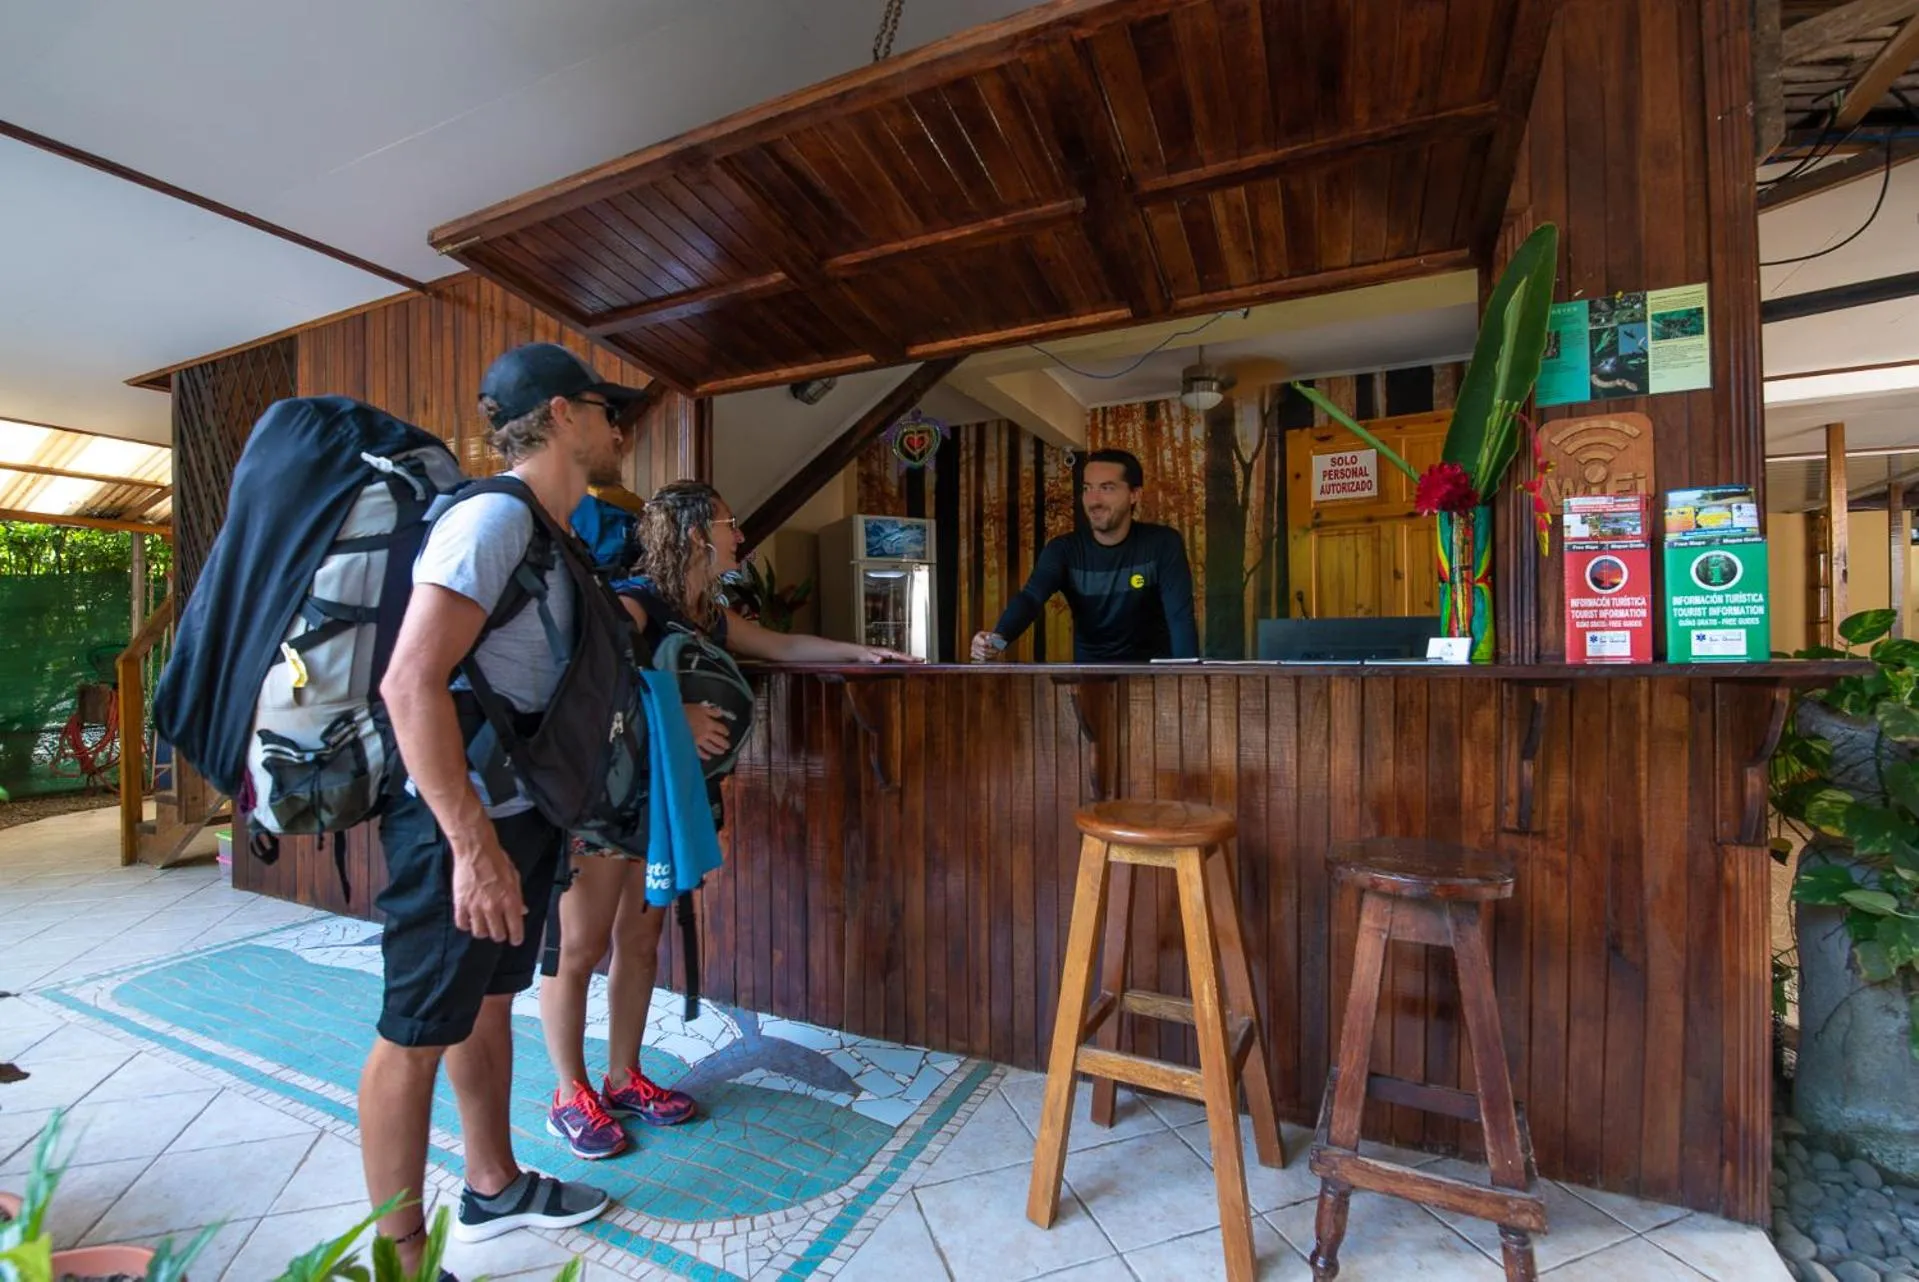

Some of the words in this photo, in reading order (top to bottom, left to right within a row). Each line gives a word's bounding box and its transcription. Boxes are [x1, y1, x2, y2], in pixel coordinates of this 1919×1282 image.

[1330, 455, 1358, 467] SOLO
[1322, 466, 1369, 481] PERSONAL
[1319, 480, 1373, 495] AUTORIZADO
[1672, 593, 1723, 605] INFORMACIÓN
[1725, 592, 1763, 604] TURÍSTICA
[1571, 609, 1598, 619] TOURIST
[1599, 608, 1647, 618] INFORMATION
[1672, 607, 1707, 617] TOURIST
[1709, 605, 1765, 616] INFORMATION
